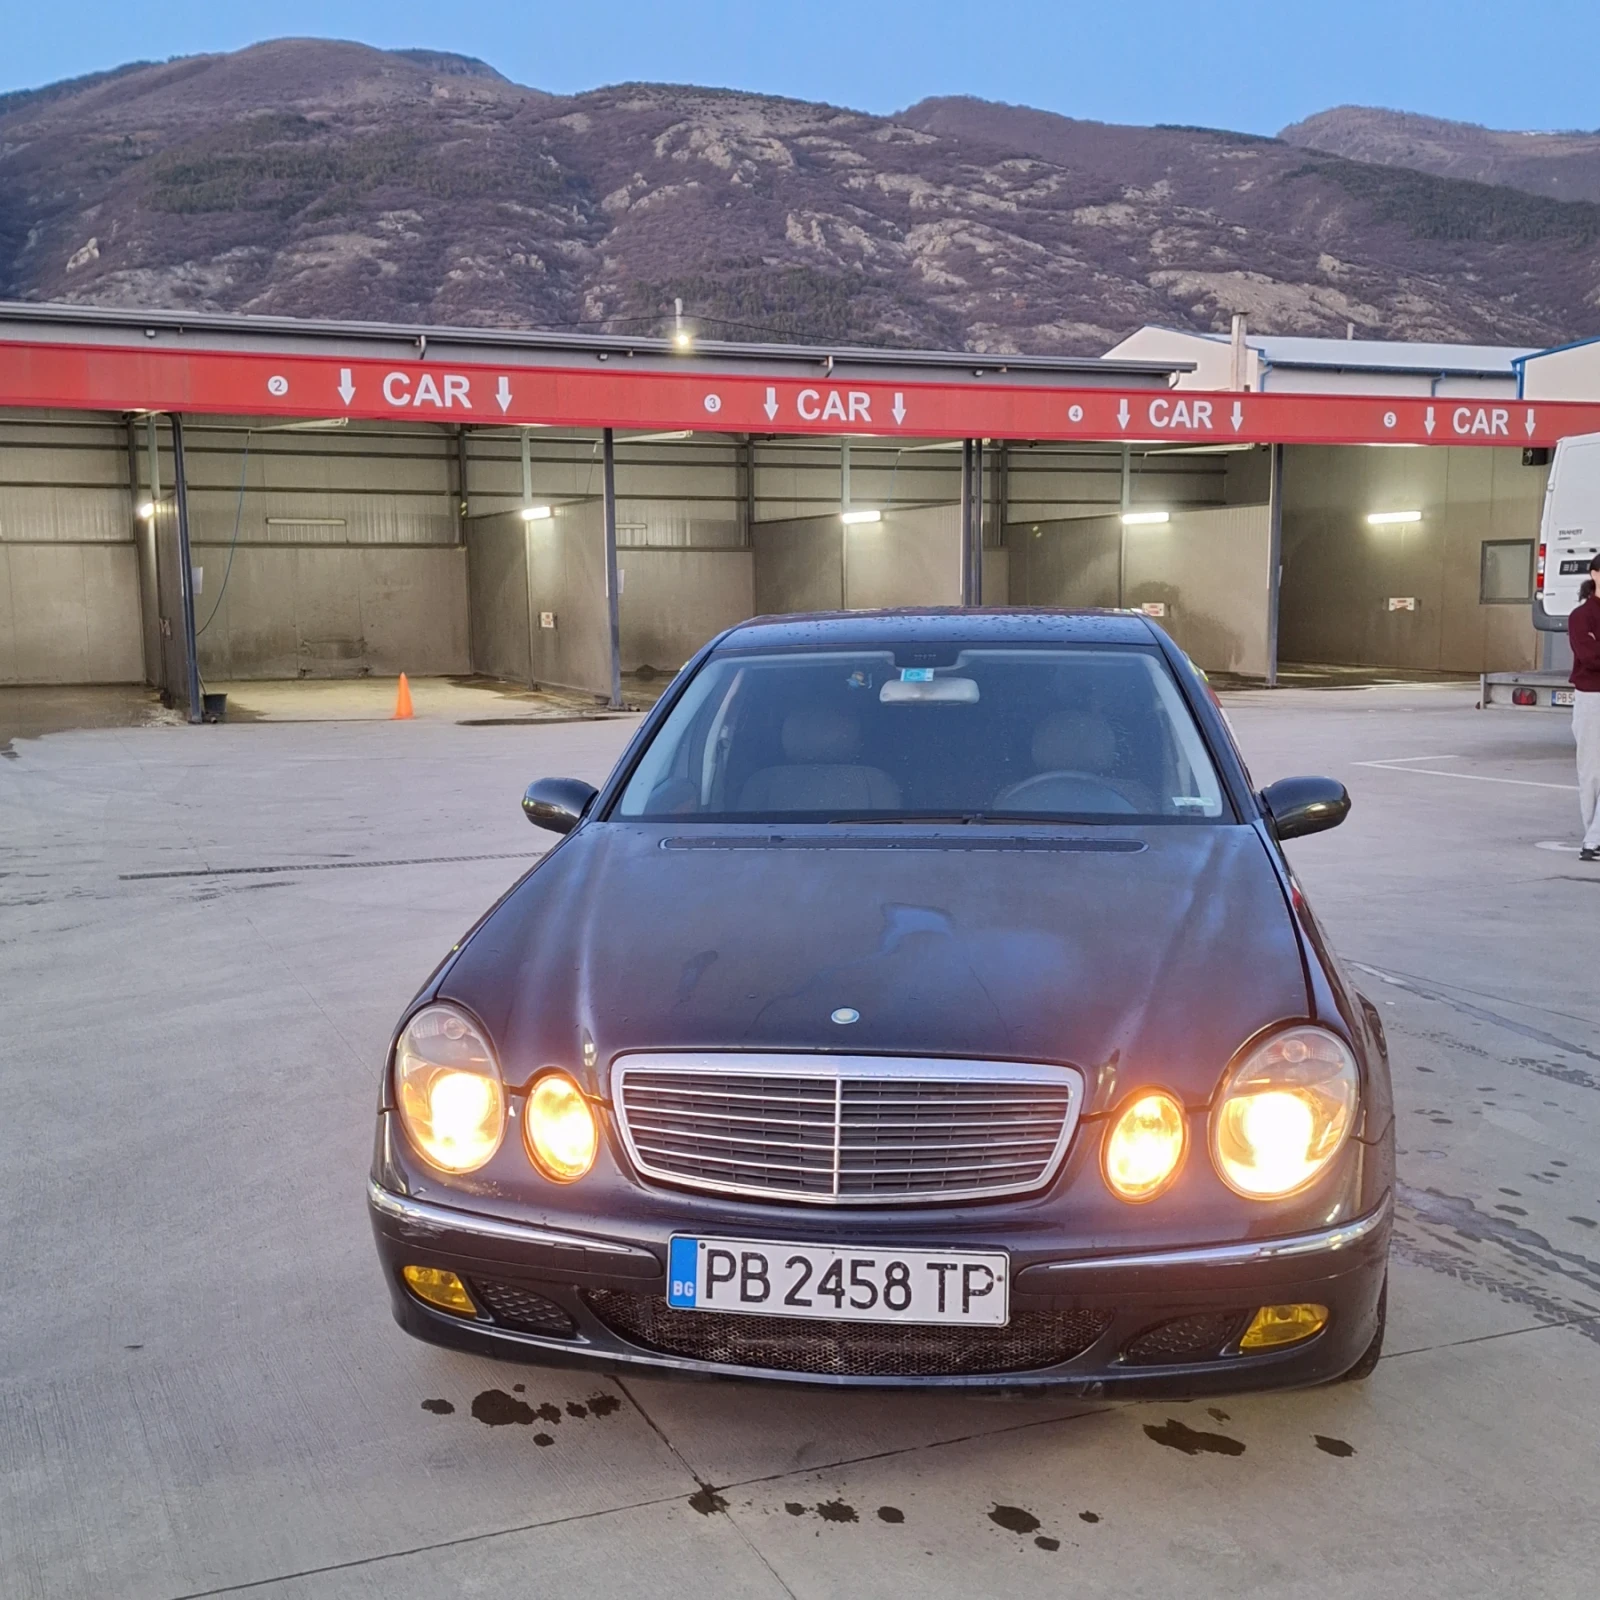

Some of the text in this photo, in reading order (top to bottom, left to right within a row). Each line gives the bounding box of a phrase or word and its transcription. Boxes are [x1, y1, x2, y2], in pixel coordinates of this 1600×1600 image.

[273, 371, 473, 409] 2 CAR
[708, 388, 872, 422] 3 CAR
[1148, 398, 1213, 429] CAR
[1452, 407, 1509, 436] CAR
[672, 1282, 694, 1297] BG
[705, 1248, 995, 1314] PB 2458 TP
